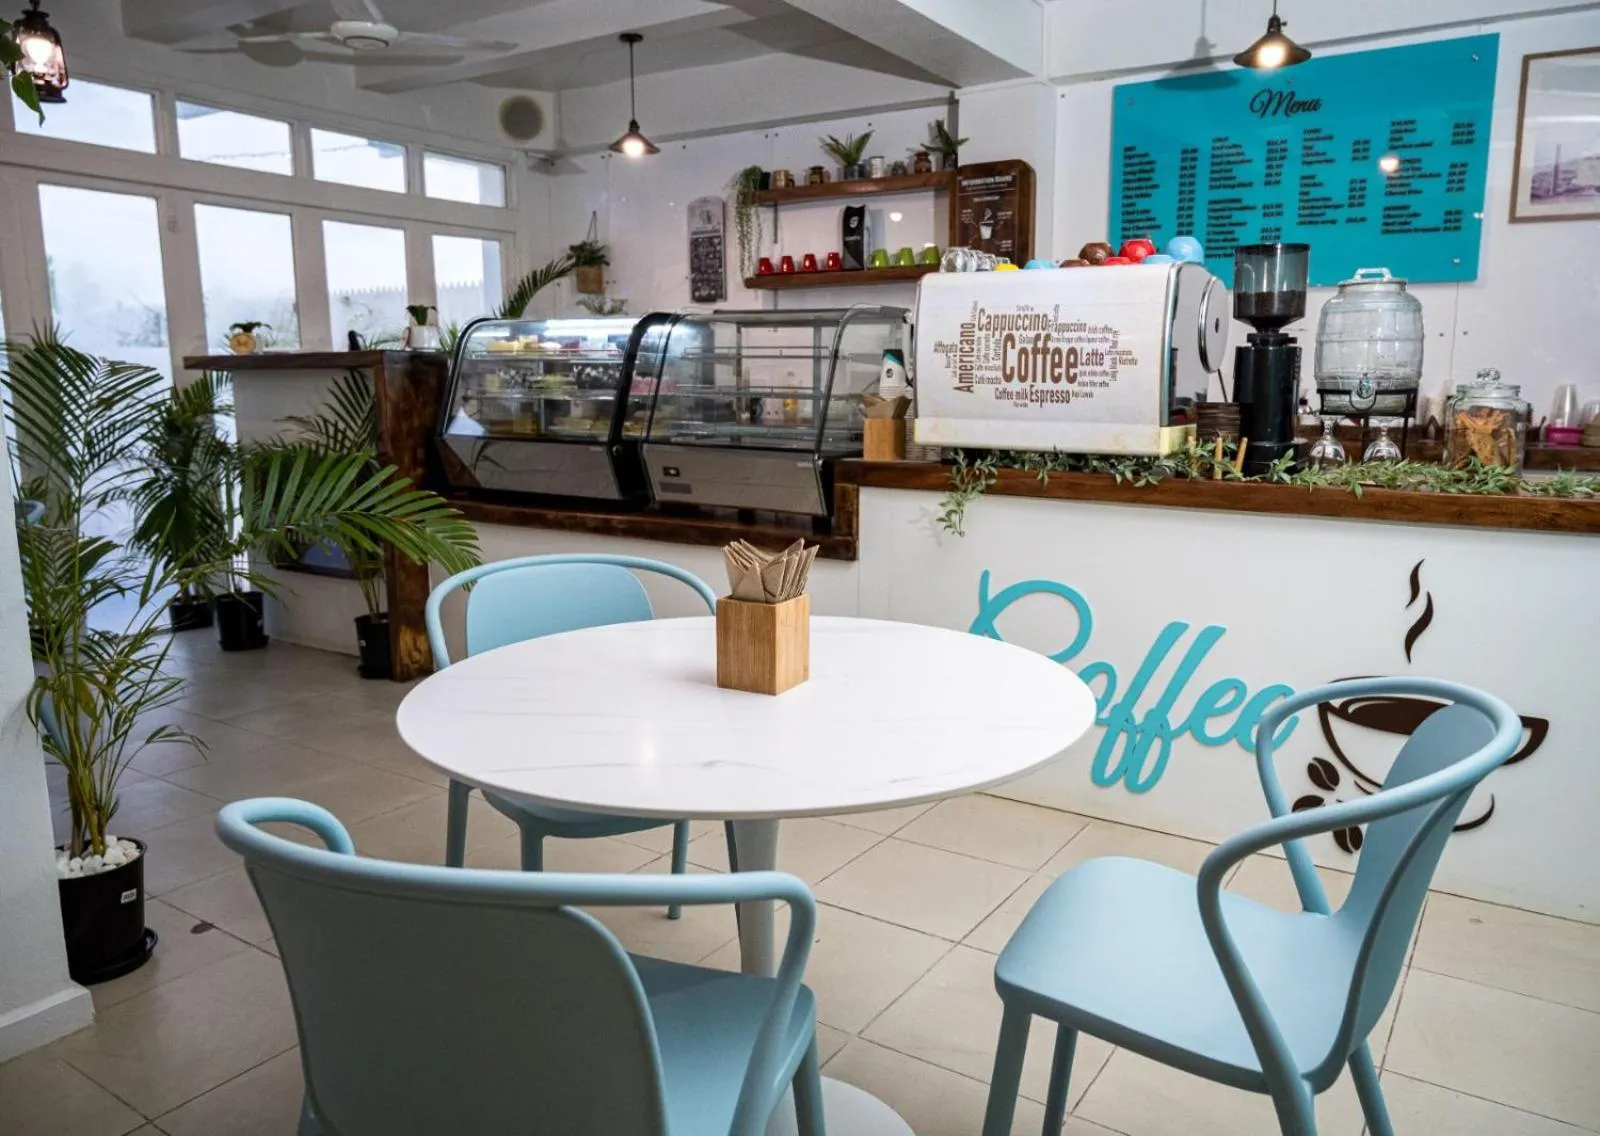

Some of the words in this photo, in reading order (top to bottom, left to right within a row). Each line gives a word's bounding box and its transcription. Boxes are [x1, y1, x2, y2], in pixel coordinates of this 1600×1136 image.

[1249, 88, 1322, 118] Menu
[977, 307, 1048, 338] Cappuccino
[1048, 319, 1087, 335] Frappuccino
[953, 322, 976, 393] Americano
[1002, 332, 1079, 384] Coffee
[1079, 346, 1105, 367] Latte
[995, 387, 1014, 401] Coffee
[1015, 387, 1029, 401] milk
[1029, 384, 1071, 408] Espresso
